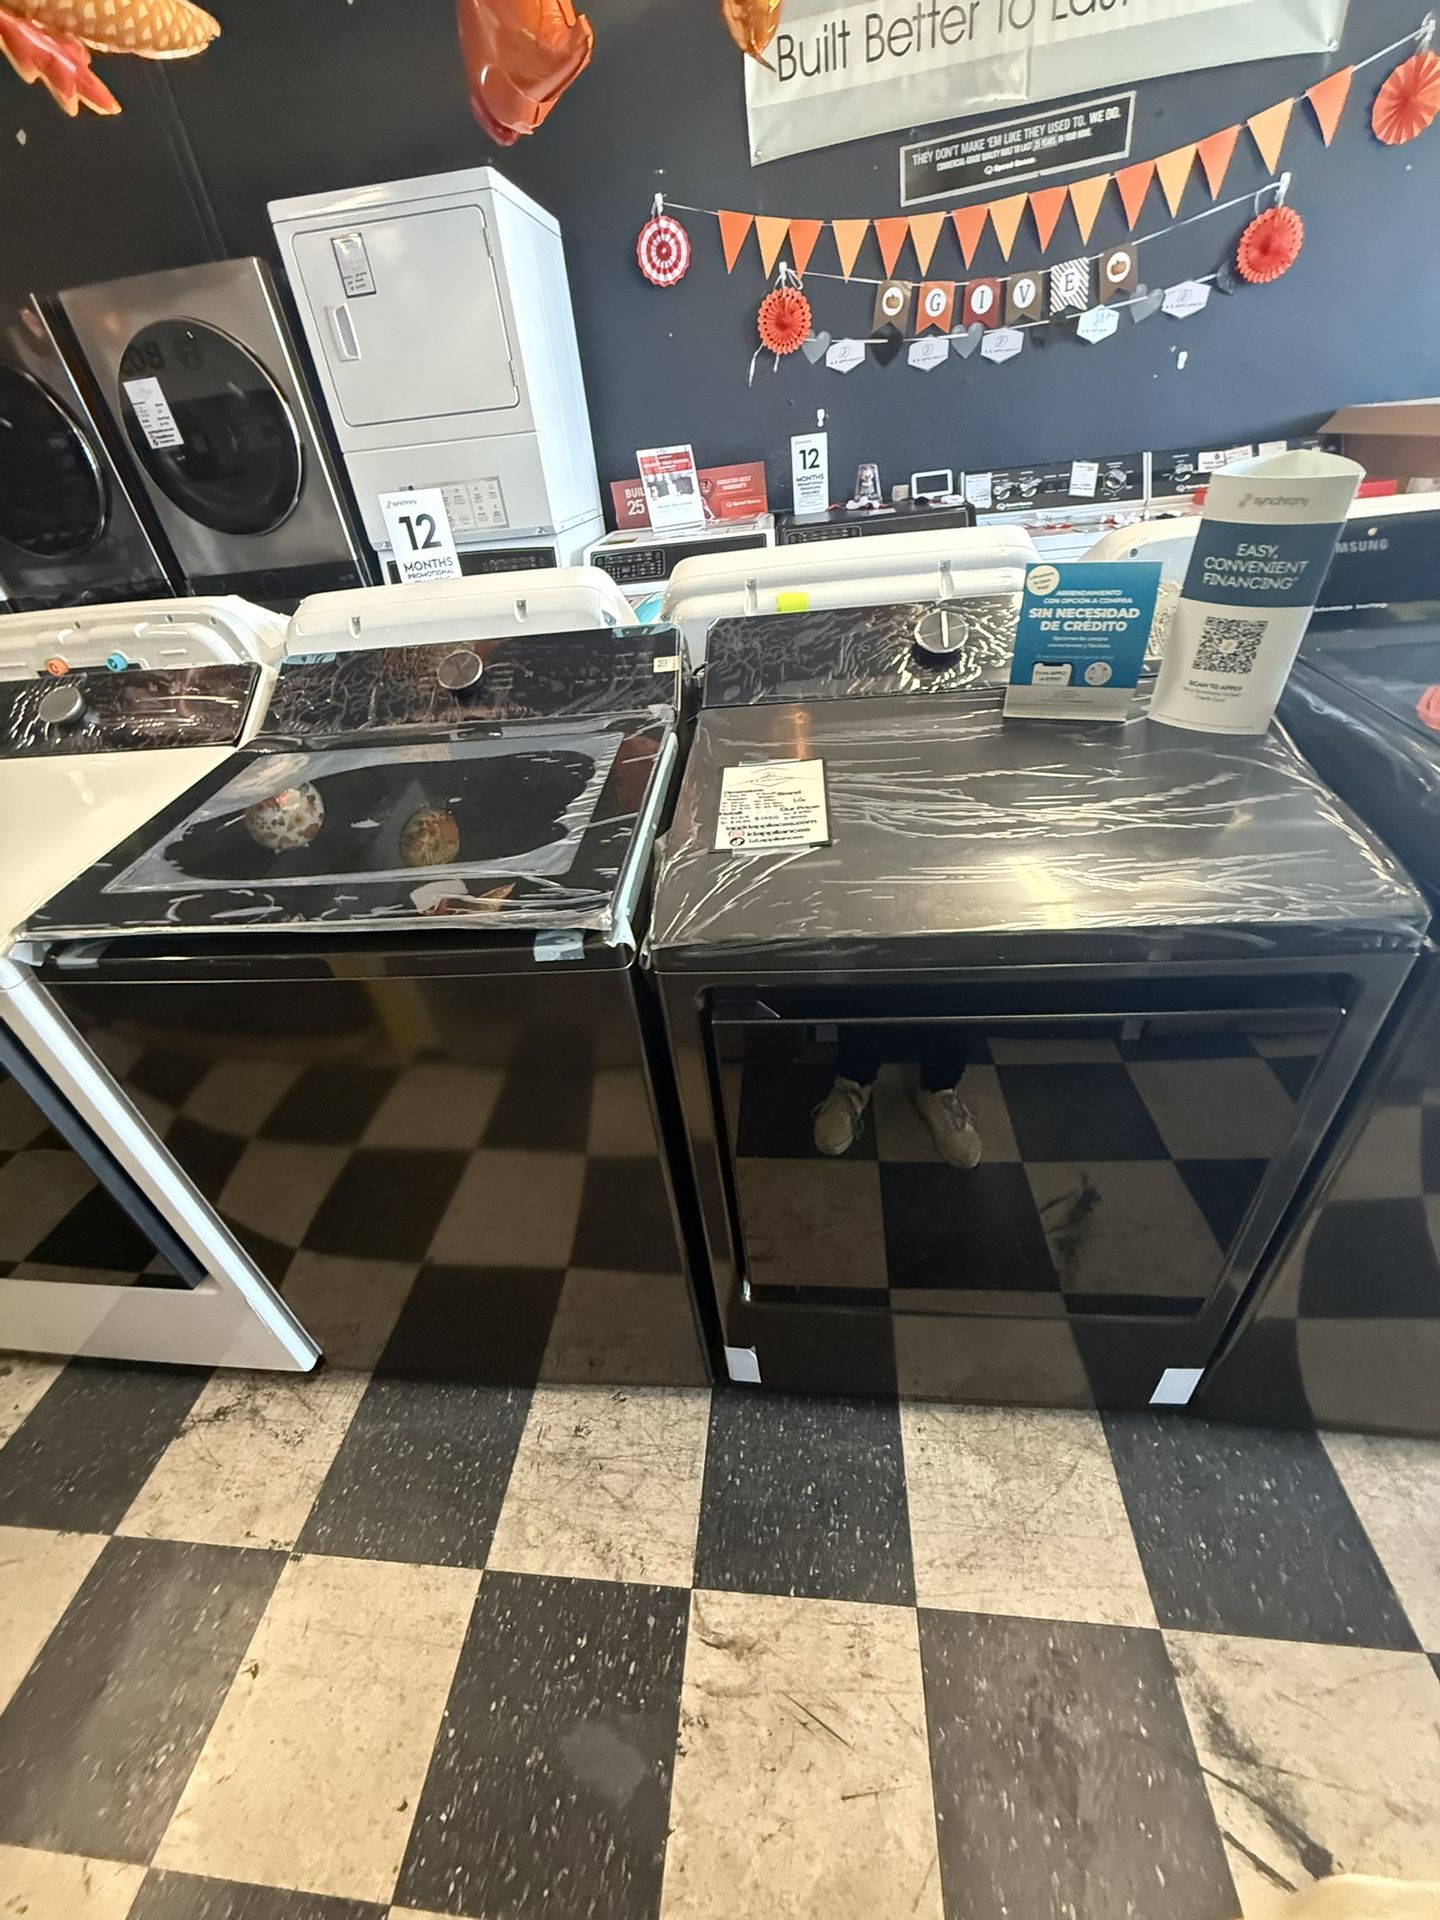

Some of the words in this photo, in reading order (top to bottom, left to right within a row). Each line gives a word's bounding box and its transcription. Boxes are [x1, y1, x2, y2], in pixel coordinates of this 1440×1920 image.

[777, 20, 851, 82] Built
[865, 0, 980, 63] Better
[912, 151, 933, 166] THEY
[935, 146, 960, 162] DON'T
[960, 139, 985, 156] MAKE
[1003, 131, 1022, 146] LIKE
[1023, 127, 1046, 141] THEY
[1047, 120, 1070, 135] USED
[1089, 110, 1105, 124] WE
[799, 448, 821, 470] 12
[796, 473, 825, 483] MONTHS
[627, 499, 645, 516] 25
[1252, 496, 1310, 508] synchrony
[398, 513, 443, 550] 12
[1235, 543, 1280, 560] EASY,
[403, 557, 454, 573] MONTHS
[1203, 557, 1310, 574] CONVENIENT
[408, 569, 455, 580] PROMOTIONAL
[1028, 607, 1053, 619] SIN
[1055, 607, 1141, 619] NECESIDAD
[1040, 620, 1061, 632] DE
[1063, 618, 1128, 632] CRÉDITO
